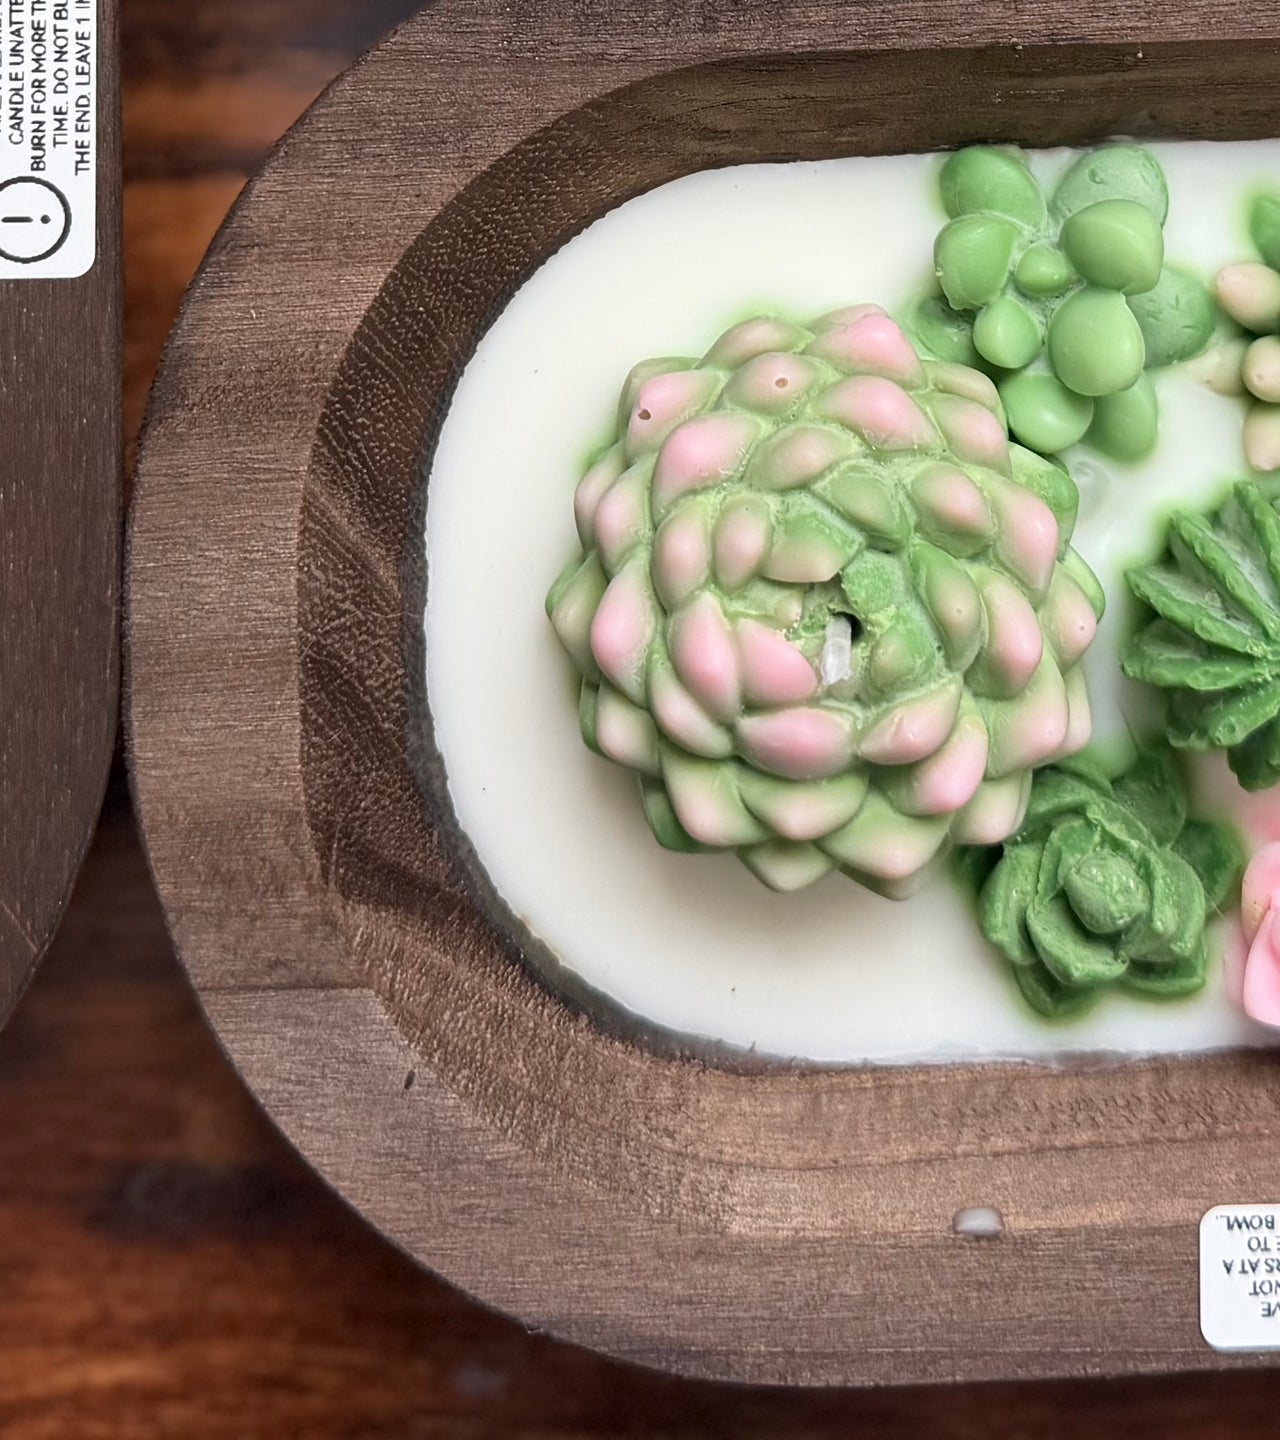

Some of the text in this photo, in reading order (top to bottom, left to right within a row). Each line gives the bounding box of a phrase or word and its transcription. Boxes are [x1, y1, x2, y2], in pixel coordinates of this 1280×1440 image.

[74, 17, 91, 26] 1
[30, 19, 46, 73] MORE
[52, 23, 69, 63] NOT
[74, 30, 91, 86] LEAVE
[30, 78, 46, 114] FOR
[52, 67, 69, 95] DO
[8, 71, 24, 145] CANDLE
[52, 100, 69, 148] TIME.
[74, 92, 91, 134] END.
[30, 120, 46, 171] BURN
[74, 136, 91, 176] THE
[1215, 1212, 1275, 1230] BOWL.
[1247, 1235, 1275, 1252] TO
[1222, 1257, 1234, 1274] A
[1238, 1257, 1261, 1274] AT
